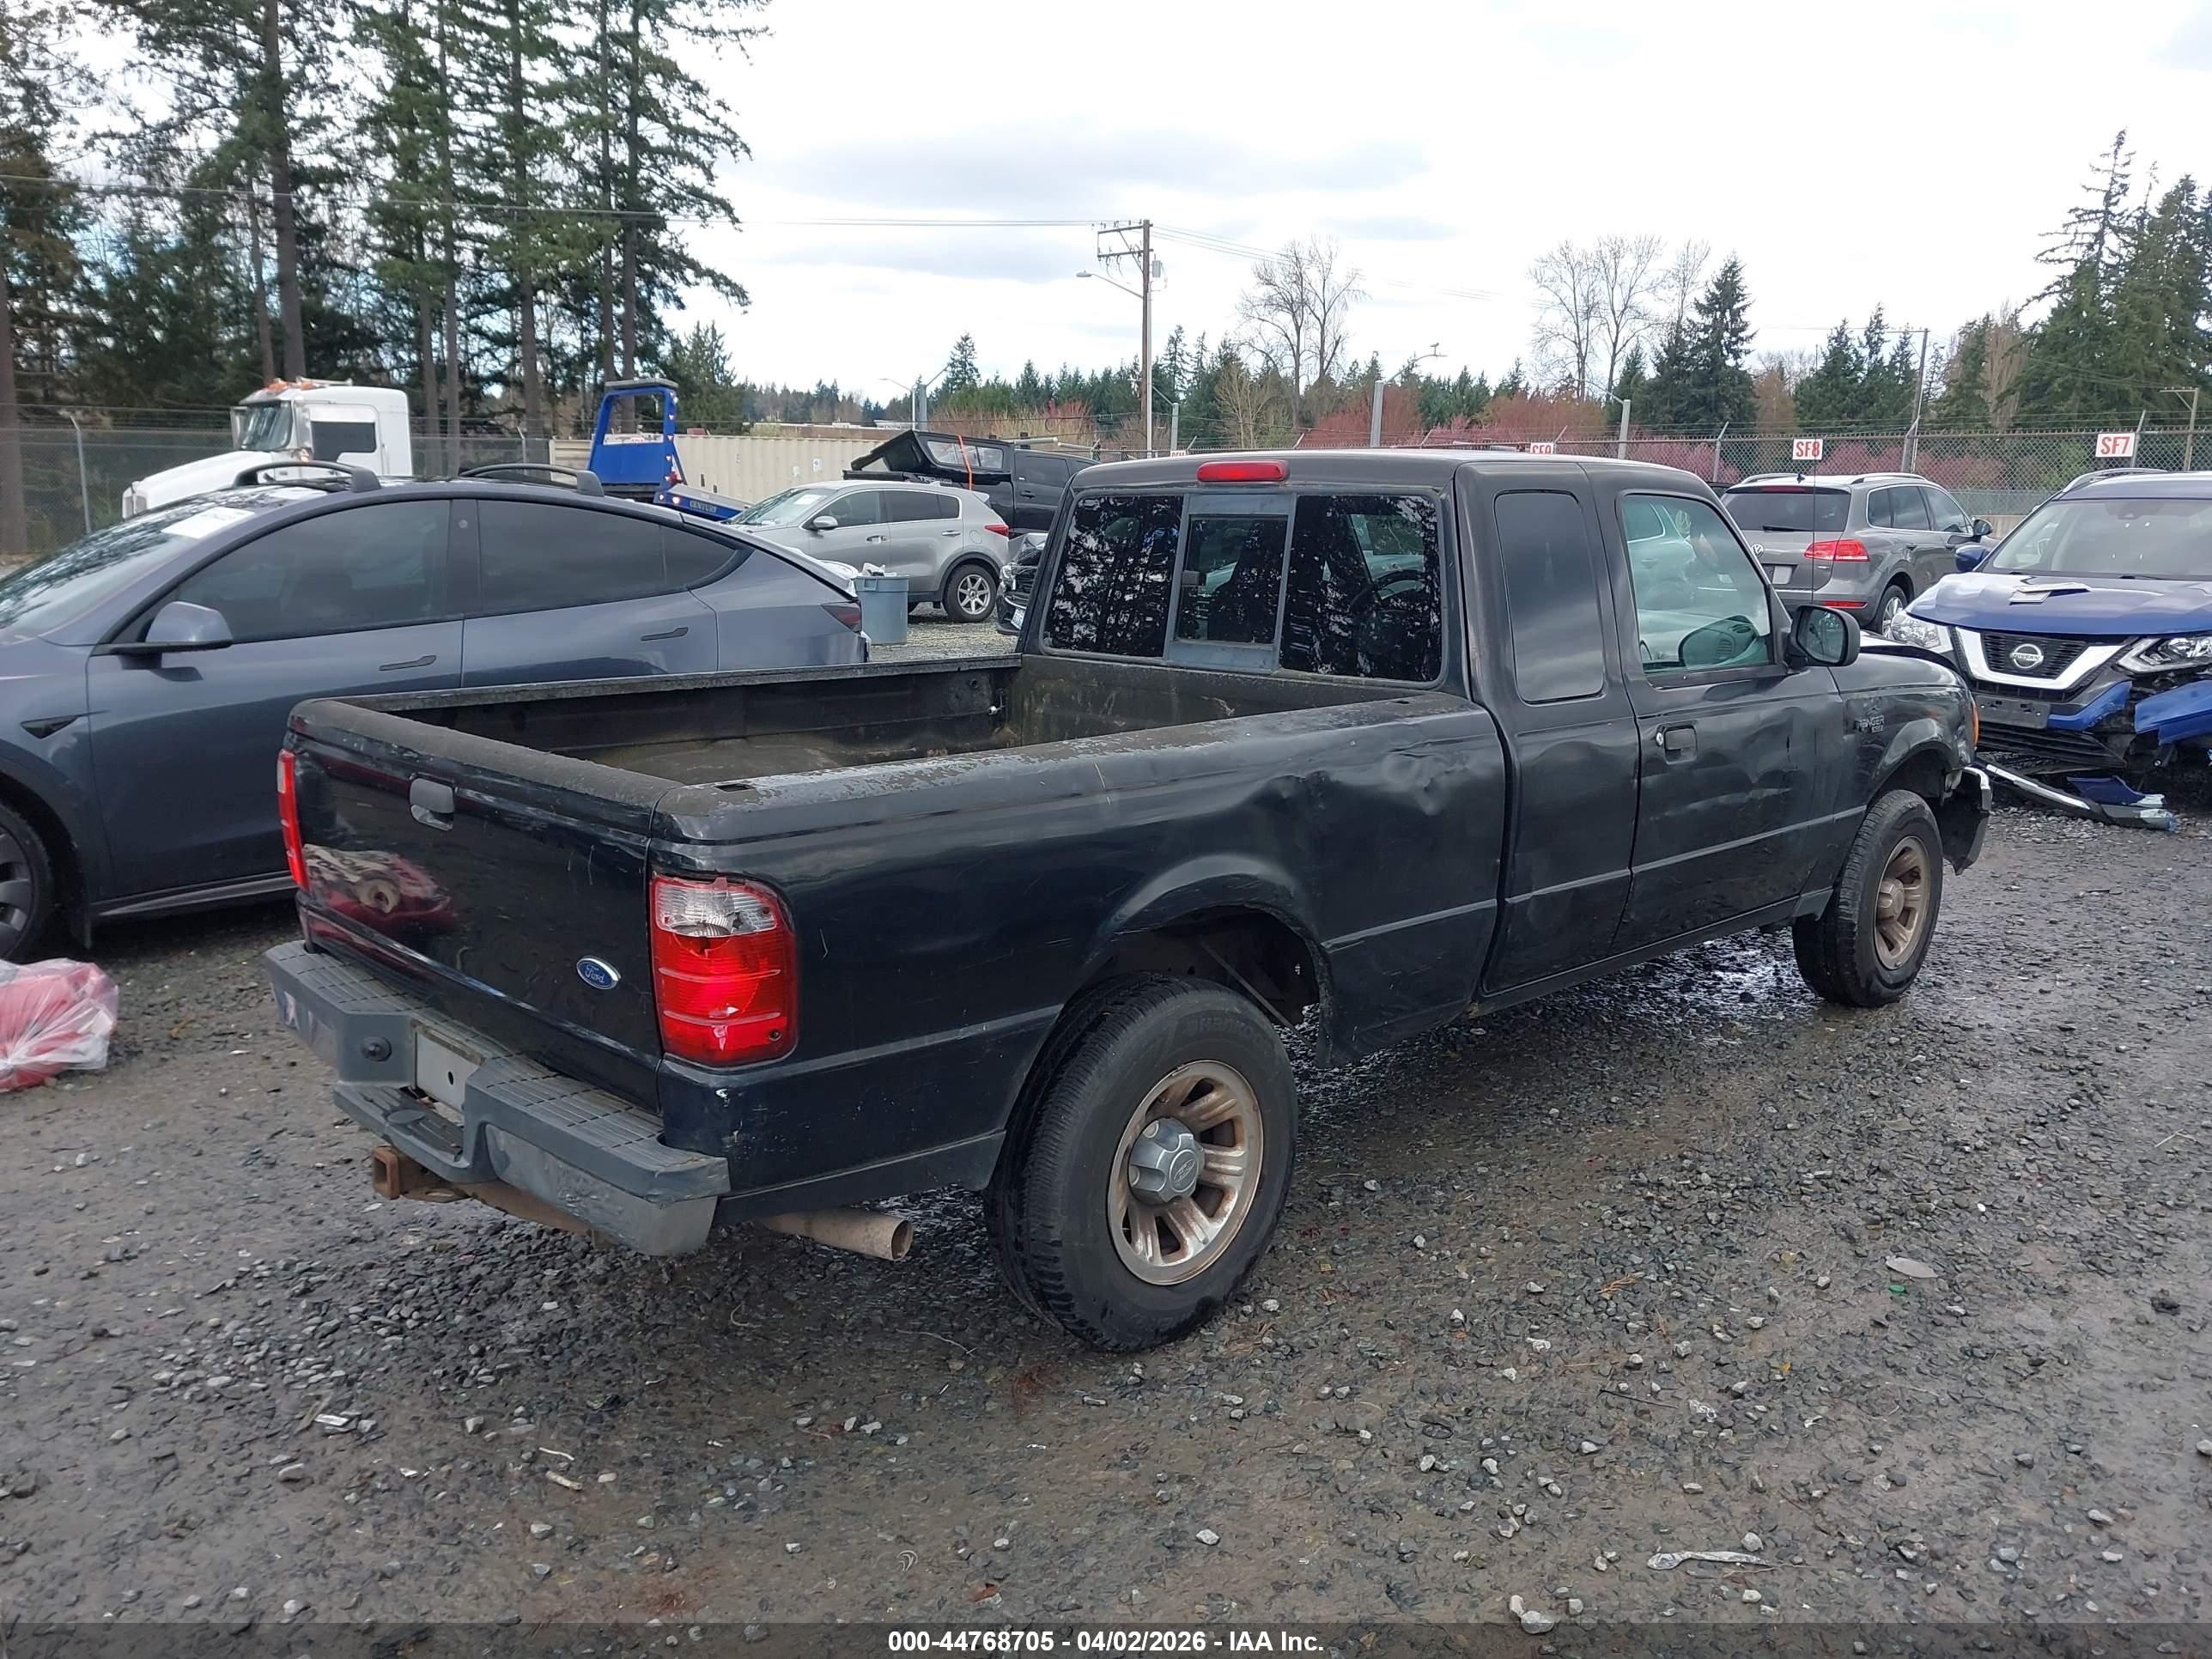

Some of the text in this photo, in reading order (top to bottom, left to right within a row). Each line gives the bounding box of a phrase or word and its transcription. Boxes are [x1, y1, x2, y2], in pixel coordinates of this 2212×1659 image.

[1796, 441, 1820, 457] SF8
[2100, 436, 2130, 454] SF7
[690, 500, 717, 513] CENTURY
[585, 964, 605, 983] Ford
